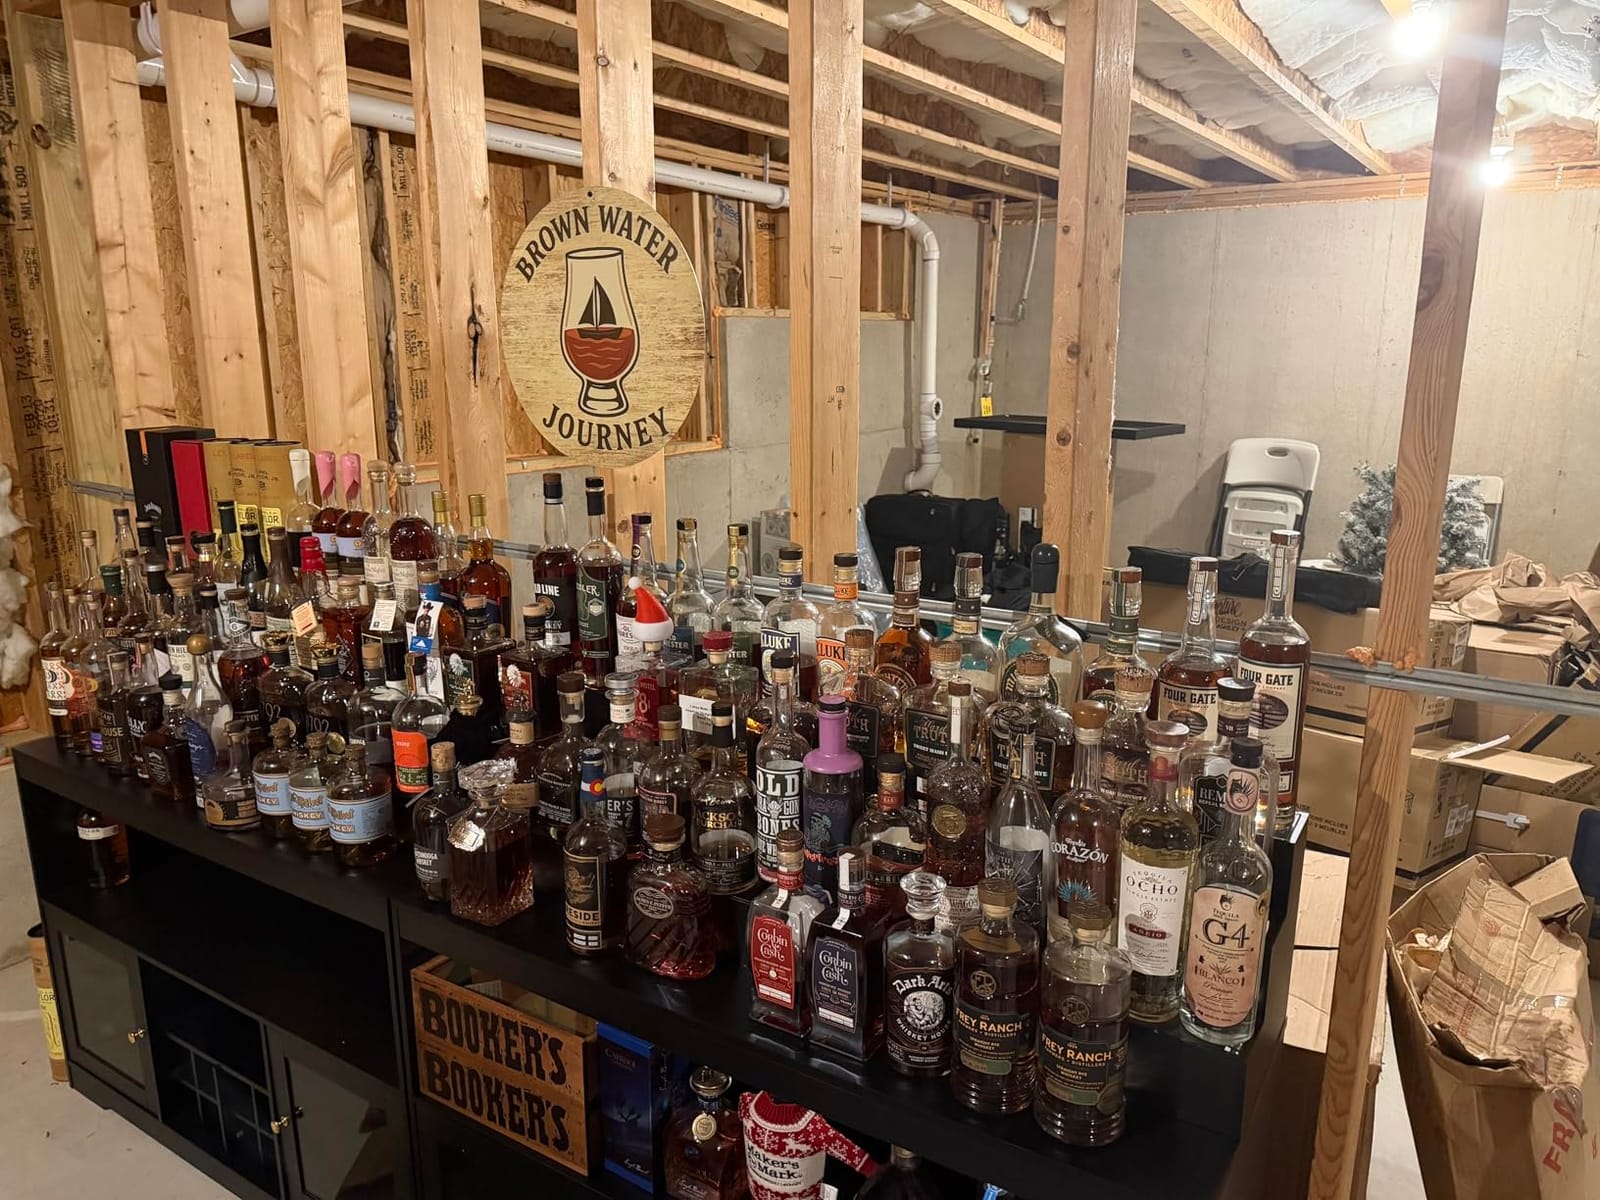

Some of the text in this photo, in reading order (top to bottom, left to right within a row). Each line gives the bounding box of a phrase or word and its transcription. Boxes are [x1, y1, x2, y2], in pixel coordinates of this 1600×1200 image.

[15, 165, 33, 221] MILL 500
[515, 204, 679, 283] BROWN WATER
[24, 412, 38, 438] FEB
[44, 397, 60, 435] 10:31
[542, 403, 670, 451] JOURNEY
[1239, 667, 1294, 687] FOUR GATE
[1163, 687, 1217, 706] FOUR GATE
[913, 725, 949, 744] TRUT
[756, 769, 800, 797] OLD
[1199, 787, 1227, 802] REM
[1126, 875, 1178, 896] OCHO
[1132, 870, 1173, 885] TEQUILA
[757, 927, 788, 948] Corbin
[1202, 917, 1250, 949] G4
[760, 943, 785, 961] Cash
[819, 949, 852, 972] Corbin
[821, 966, 848, 986] Cash
[892, 974, 926, 995] Dark
[1199, 968, 1241, 986] BLANCO
[896, 1017, 928, 1042] WHISKEY
[955, 1007, 1022, 1033] FREY RANCH
[418, 987, 567, 1086] BOOKER'S
[1041, 1032, 1112, 1063] FREY RANCH
[422, 1050, 571, 1152] BOOKER'S
